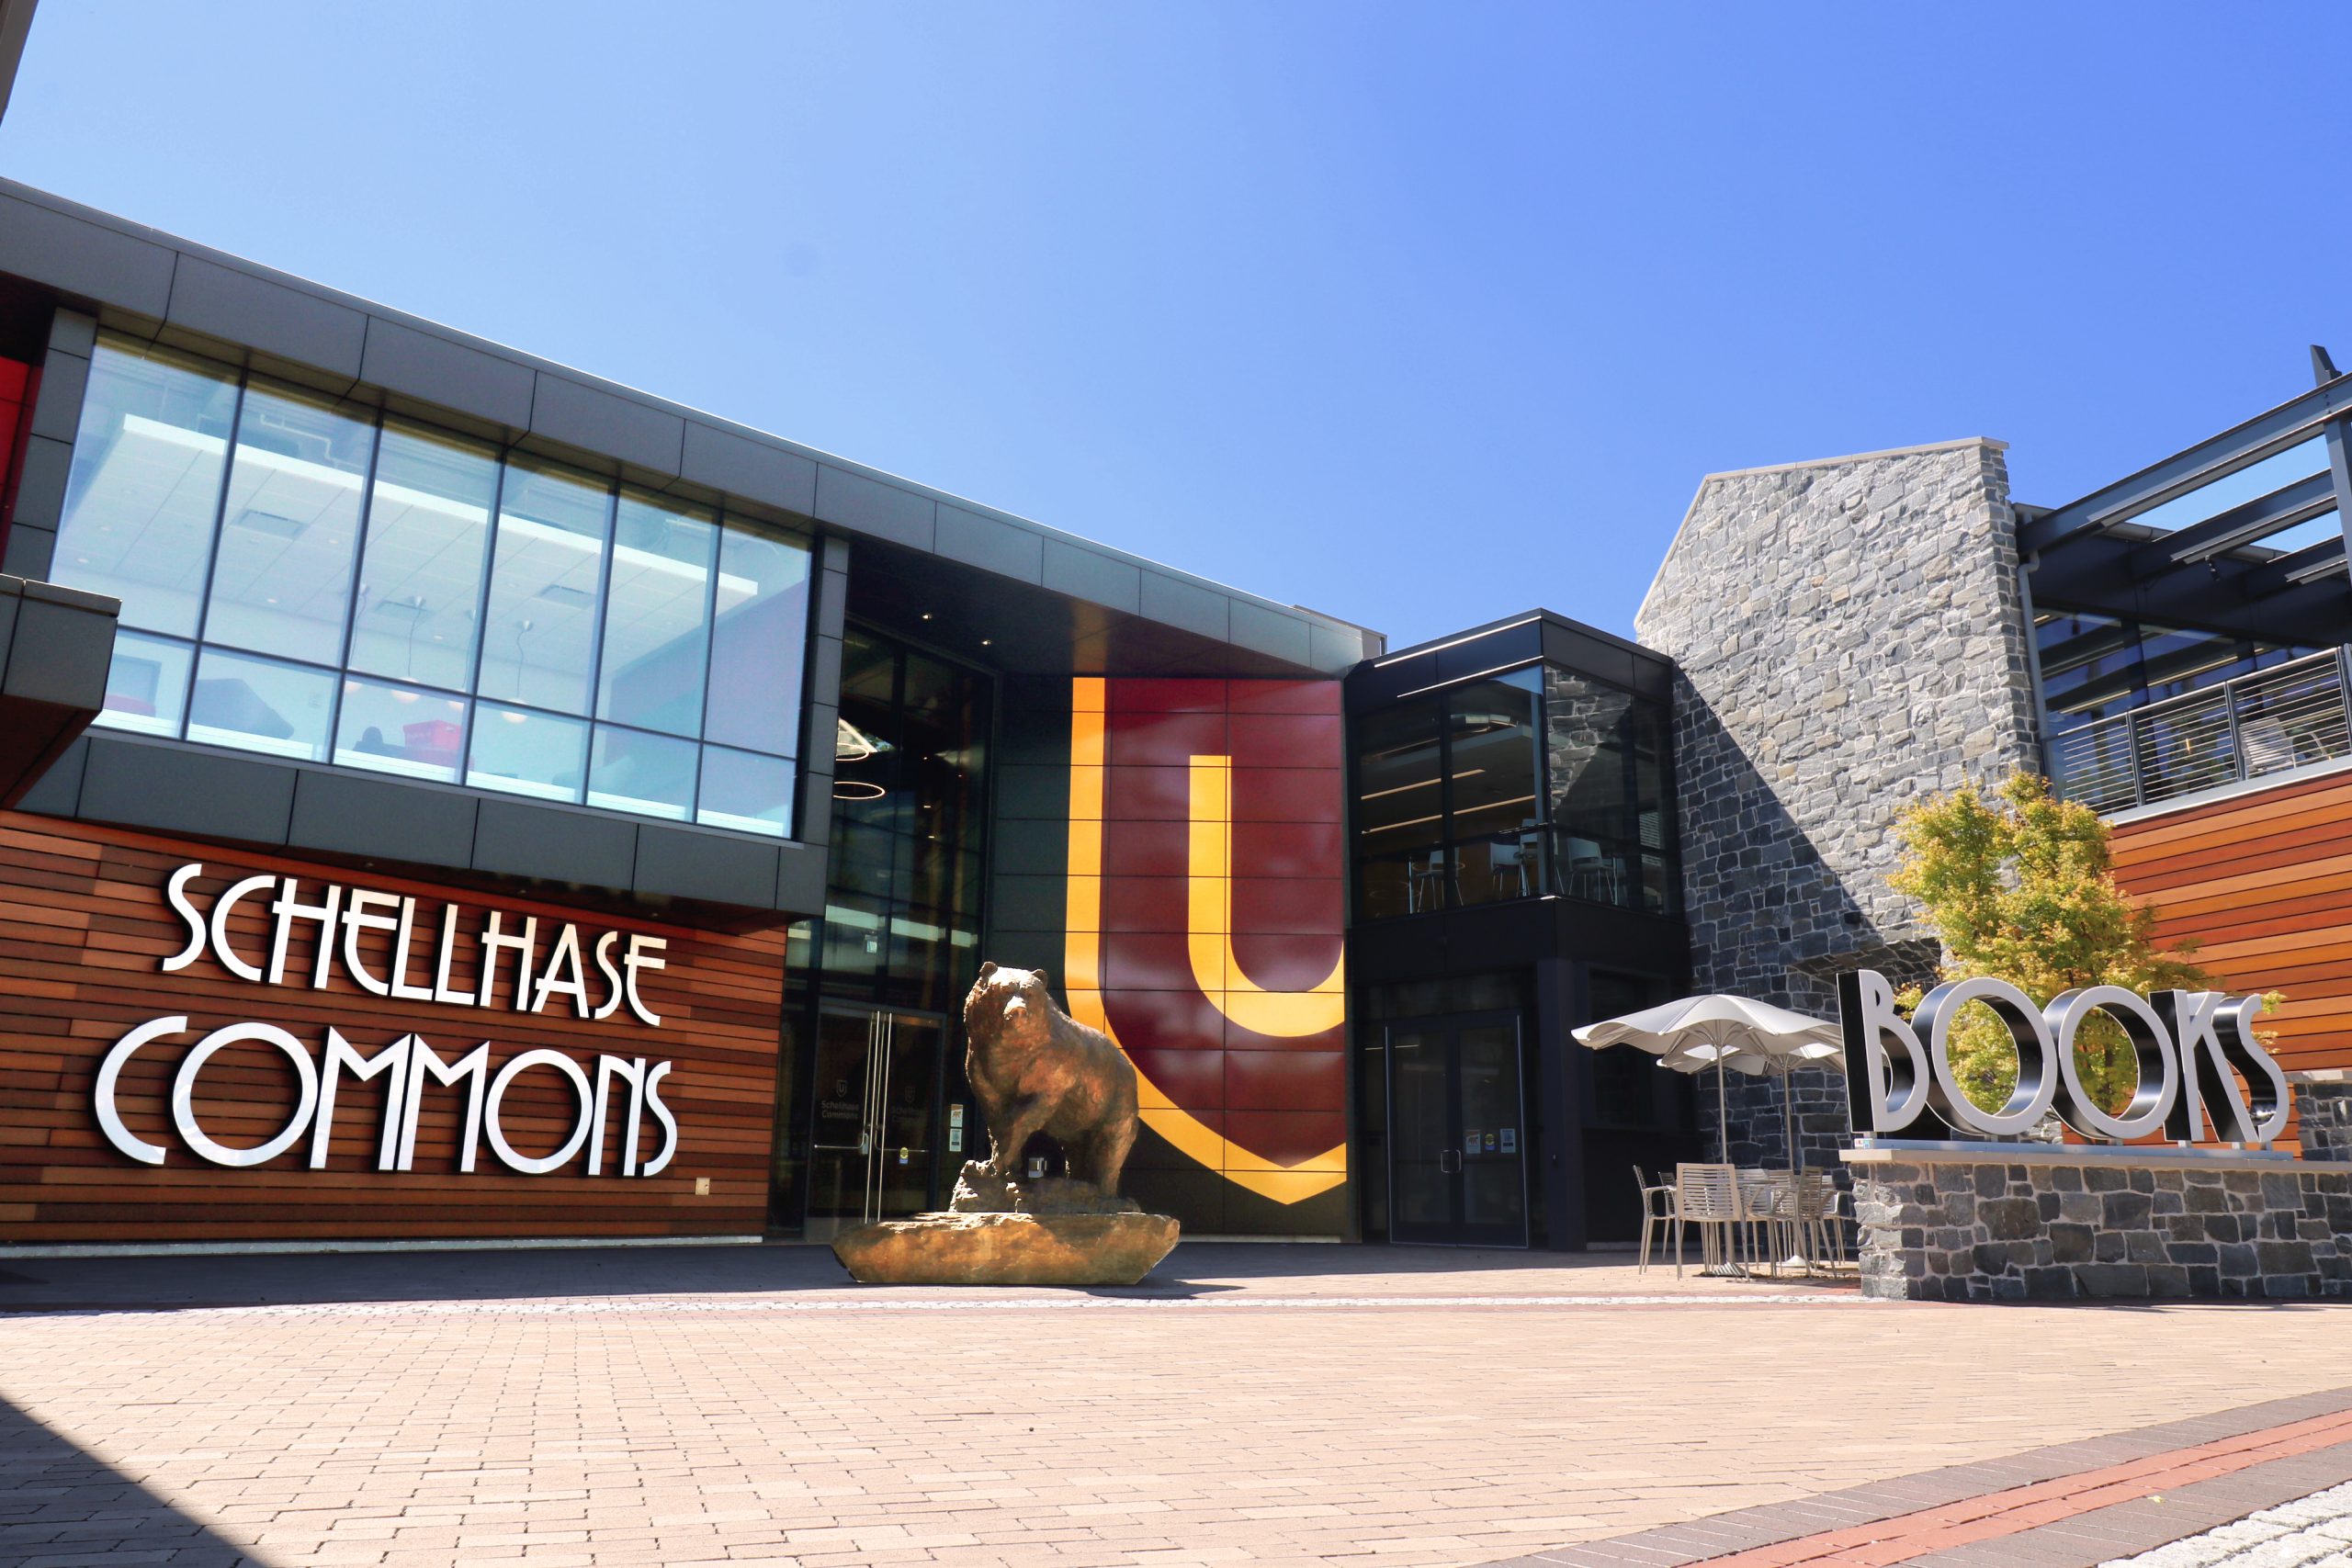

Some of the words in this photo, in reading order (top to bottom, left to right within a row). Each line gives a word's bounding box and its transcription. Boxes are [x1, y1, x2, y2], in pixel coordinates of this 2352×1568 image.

[163, 863, 667, 1026] SCHELLHASE
[95, 1015, 678, 1177] COMMONS
[1837, 969, 2290, 1143] BOOKS
